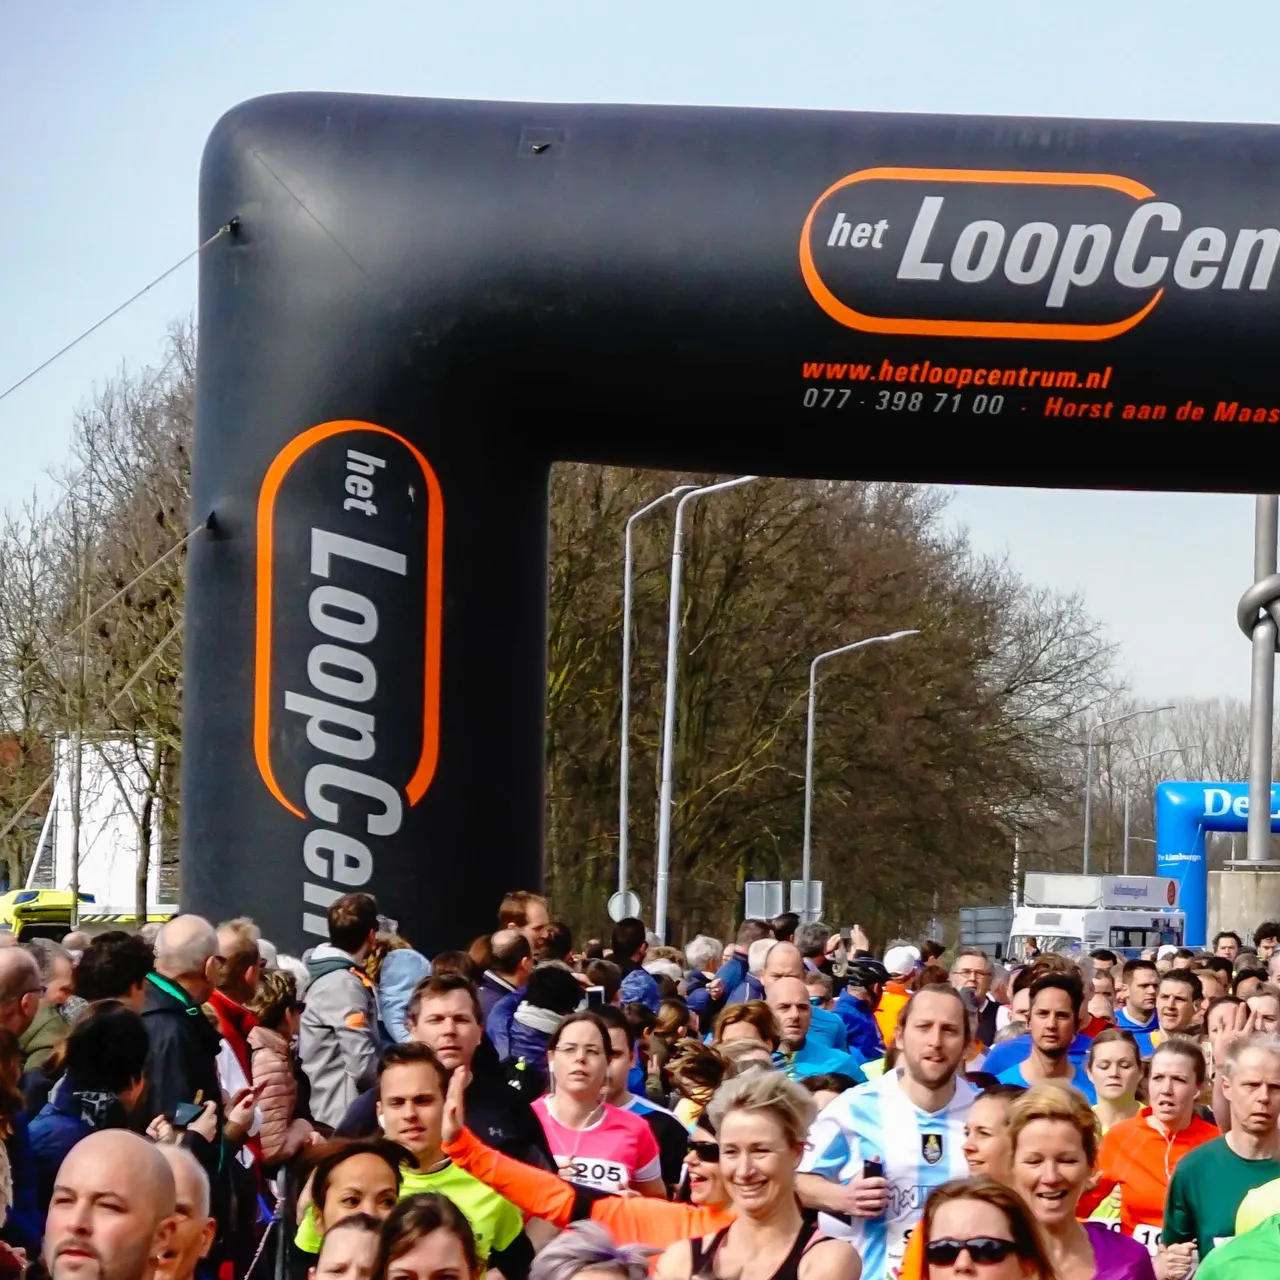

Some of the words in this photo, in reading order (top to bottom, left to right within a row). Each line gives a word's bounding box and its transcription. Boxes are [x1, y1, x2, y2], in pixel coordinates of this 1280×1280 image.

[827, 212, 890, 250] het
[802, 358, 1113, 391] www.hetloopcentrum.nl
[802, 388, 851, 410] 077
[875, 390, 923, 412] 398
[932, 392, 962, 414] 71
[972, 394, 1005, 415] 00
[1044, 397, 1113, 420] Horst
[1122, 402, 1167, 422] aan
[1175, 401, 1205, 423] de
[344, 448, 386, 517] het
[1202, 788, 1249, 818] De
